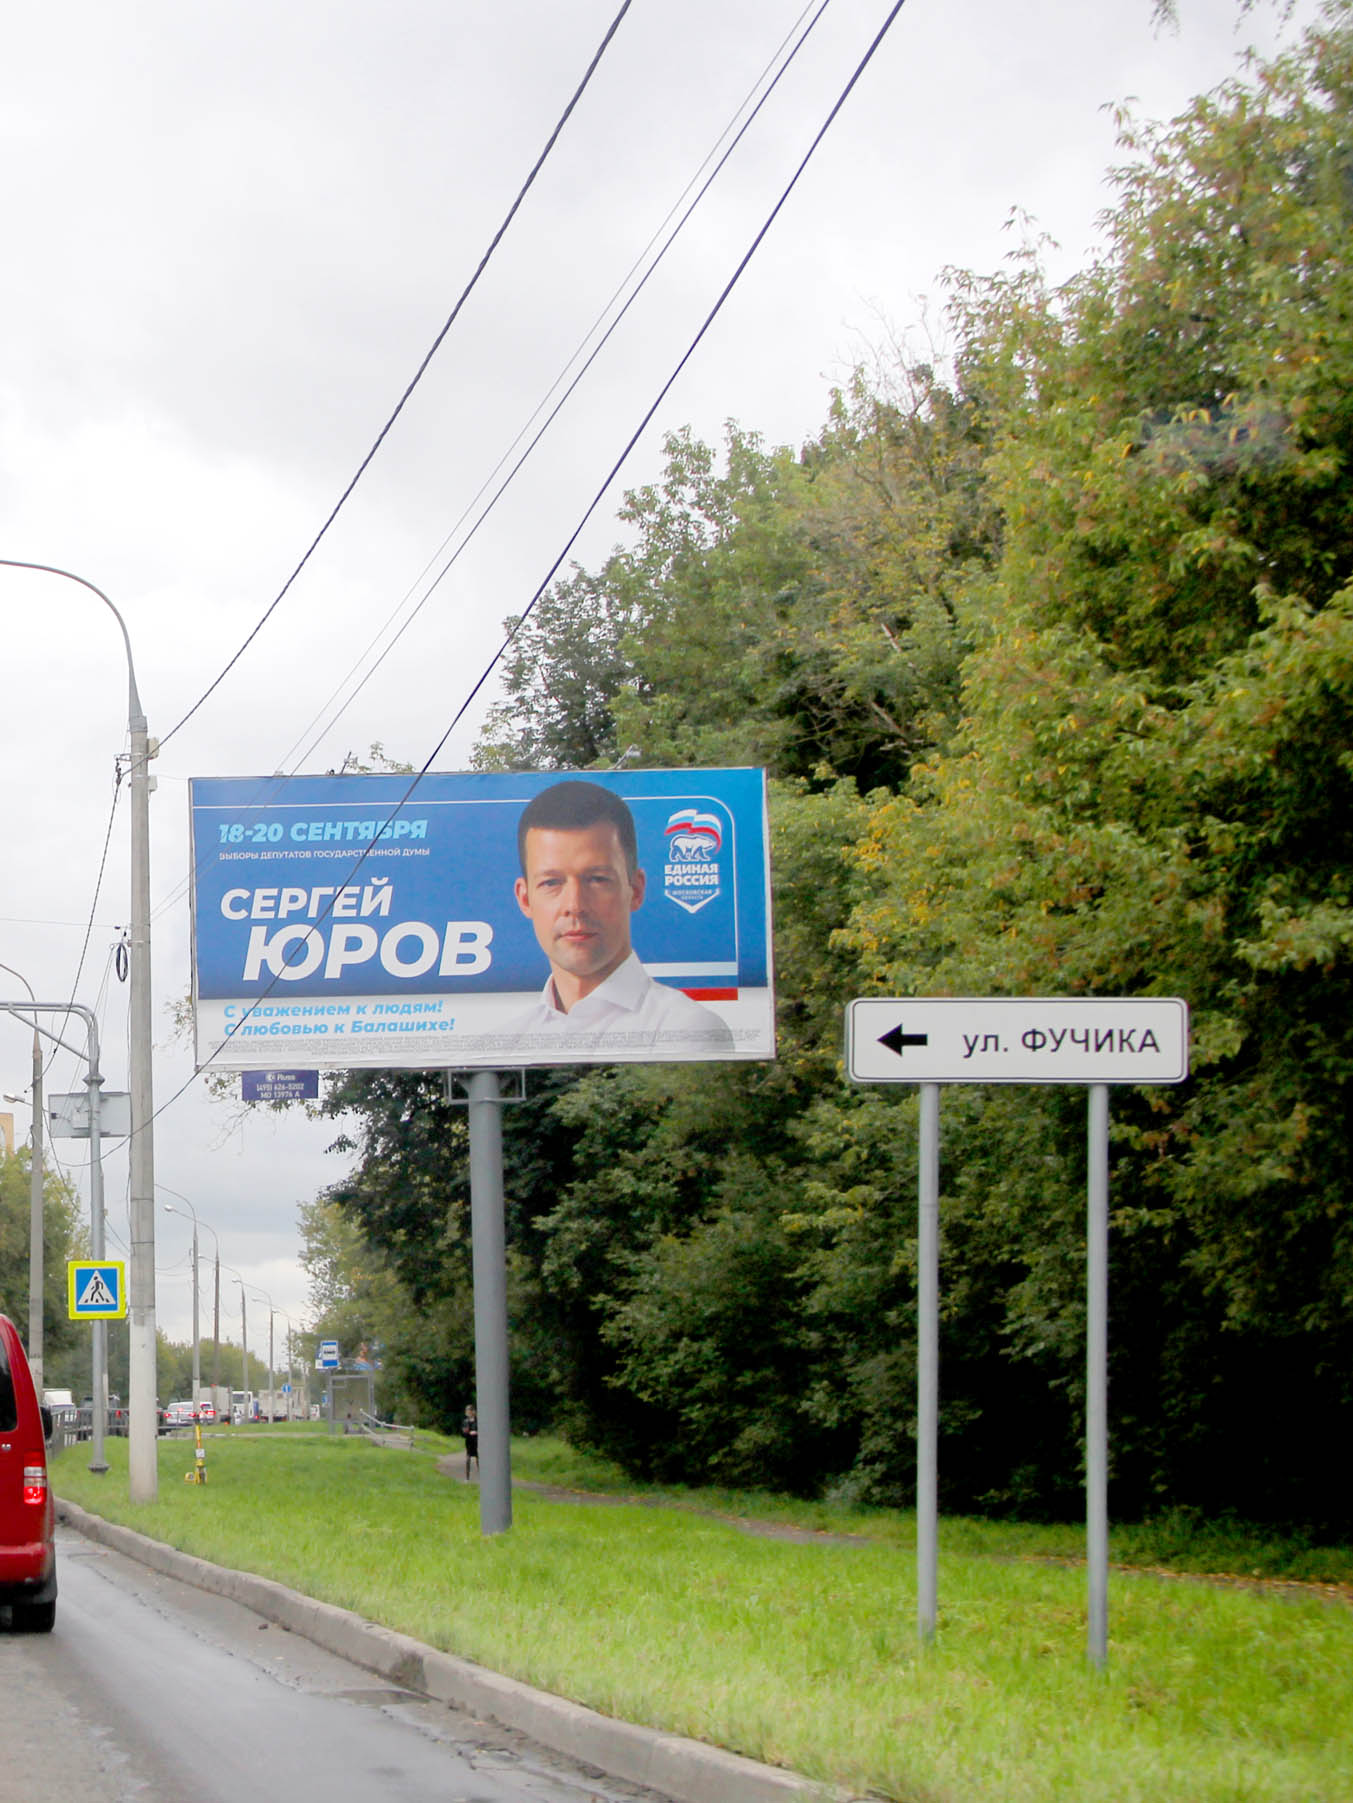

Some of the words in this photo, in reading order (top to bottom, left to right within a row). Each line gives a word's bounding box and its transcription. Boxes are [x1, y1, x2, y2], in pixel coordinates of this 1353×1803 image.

[218, 823, 284, 843] 18-20
[290, 820, 428, 842] СЕНТЯБРЯ
[219, 851, 260, 860] ВЫБОРЫ
[260, 850, 312, 860] ДЕПУТАТОВ
[313, 848, 401, 858] ГОСУДАРСТВЕННОЙ
[402, 847, 430, 857] ДУМЫ
[664, 863, 719, 875] ЕДИНАЯ
[664, 874, 719, 886] РОССИЯ
[220, 877, 394, 920] СЕРГЕЙ
[242, 920, 494, 981] ЮРОВ
[224, 1005, 236, 1018] С
[241, 1003, 350, 1019] уважением
[356, 1004, 367, 1015] к
[372, 1000, 443, 1015] людям!
[224, 1023, 236, 1036] С
[240, 1022, 329, 1036] любовью
[334, 1023, 345, 1034] к
[351, 1018, 455, 1034] Балашихе!
[963, 1034, 1009, 1058] ул.
[1021, 1028, 1161, 1053] ФУЧИКА
